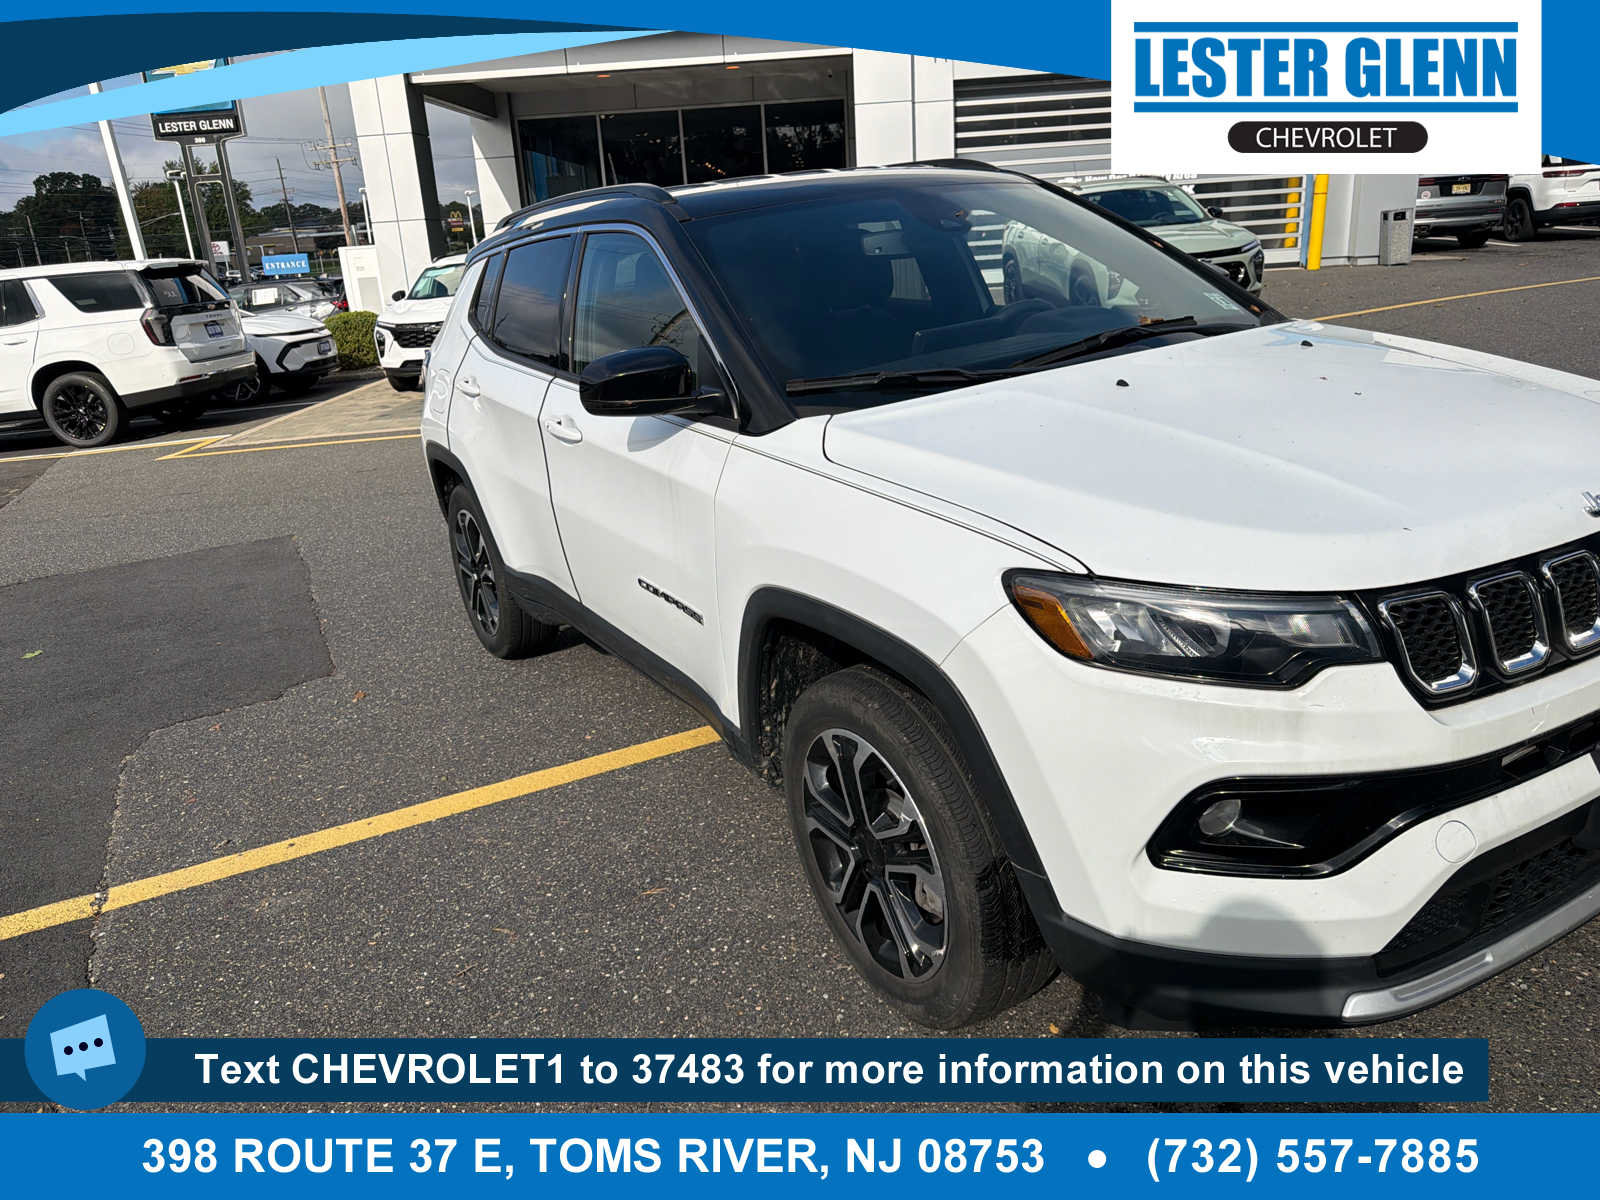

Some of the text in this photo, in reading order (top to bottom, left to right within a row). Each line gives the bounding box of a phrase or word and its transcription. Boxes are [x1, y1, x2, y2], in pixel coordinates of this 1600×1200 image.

[158, 119, 234, 133] LESTER GLENN
[265, 260, 307, 270] ENTRANCE
[637, 578, 705, 625] COMPASS
